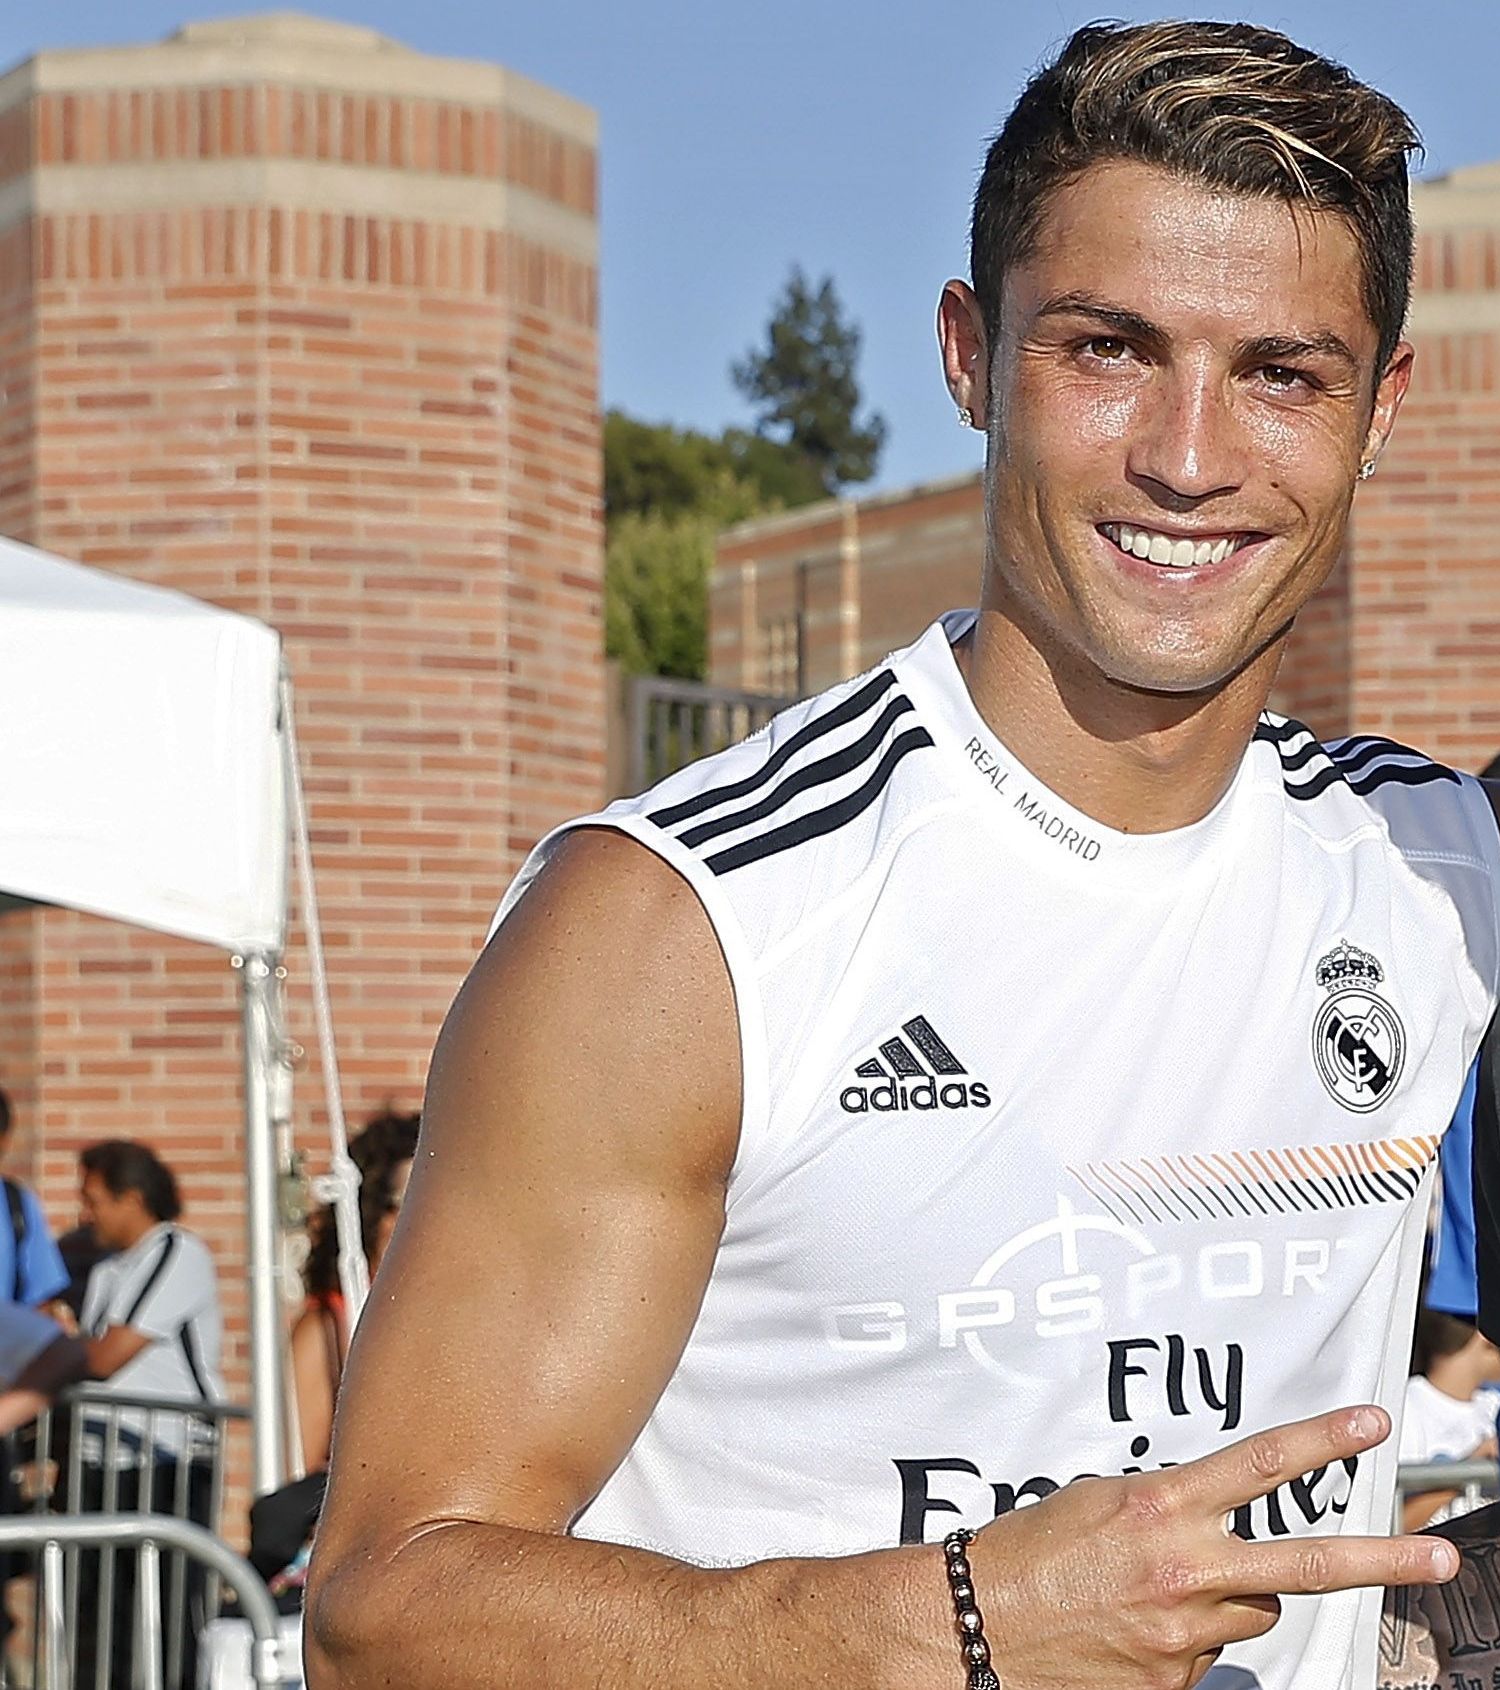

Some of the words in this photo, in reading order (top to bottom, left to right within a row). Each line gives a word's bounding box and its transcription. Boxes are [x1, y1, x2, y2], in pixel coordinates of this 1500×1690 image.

[964, 736, 1010, 795] REAL
[1013, 792, 1101, 861] MADRID
[840, 1075, 991, 1113] adidas
[828, 1237, 1354, 1352] GPSPOR
[1109, 1335, 1243, 1431] Fly
